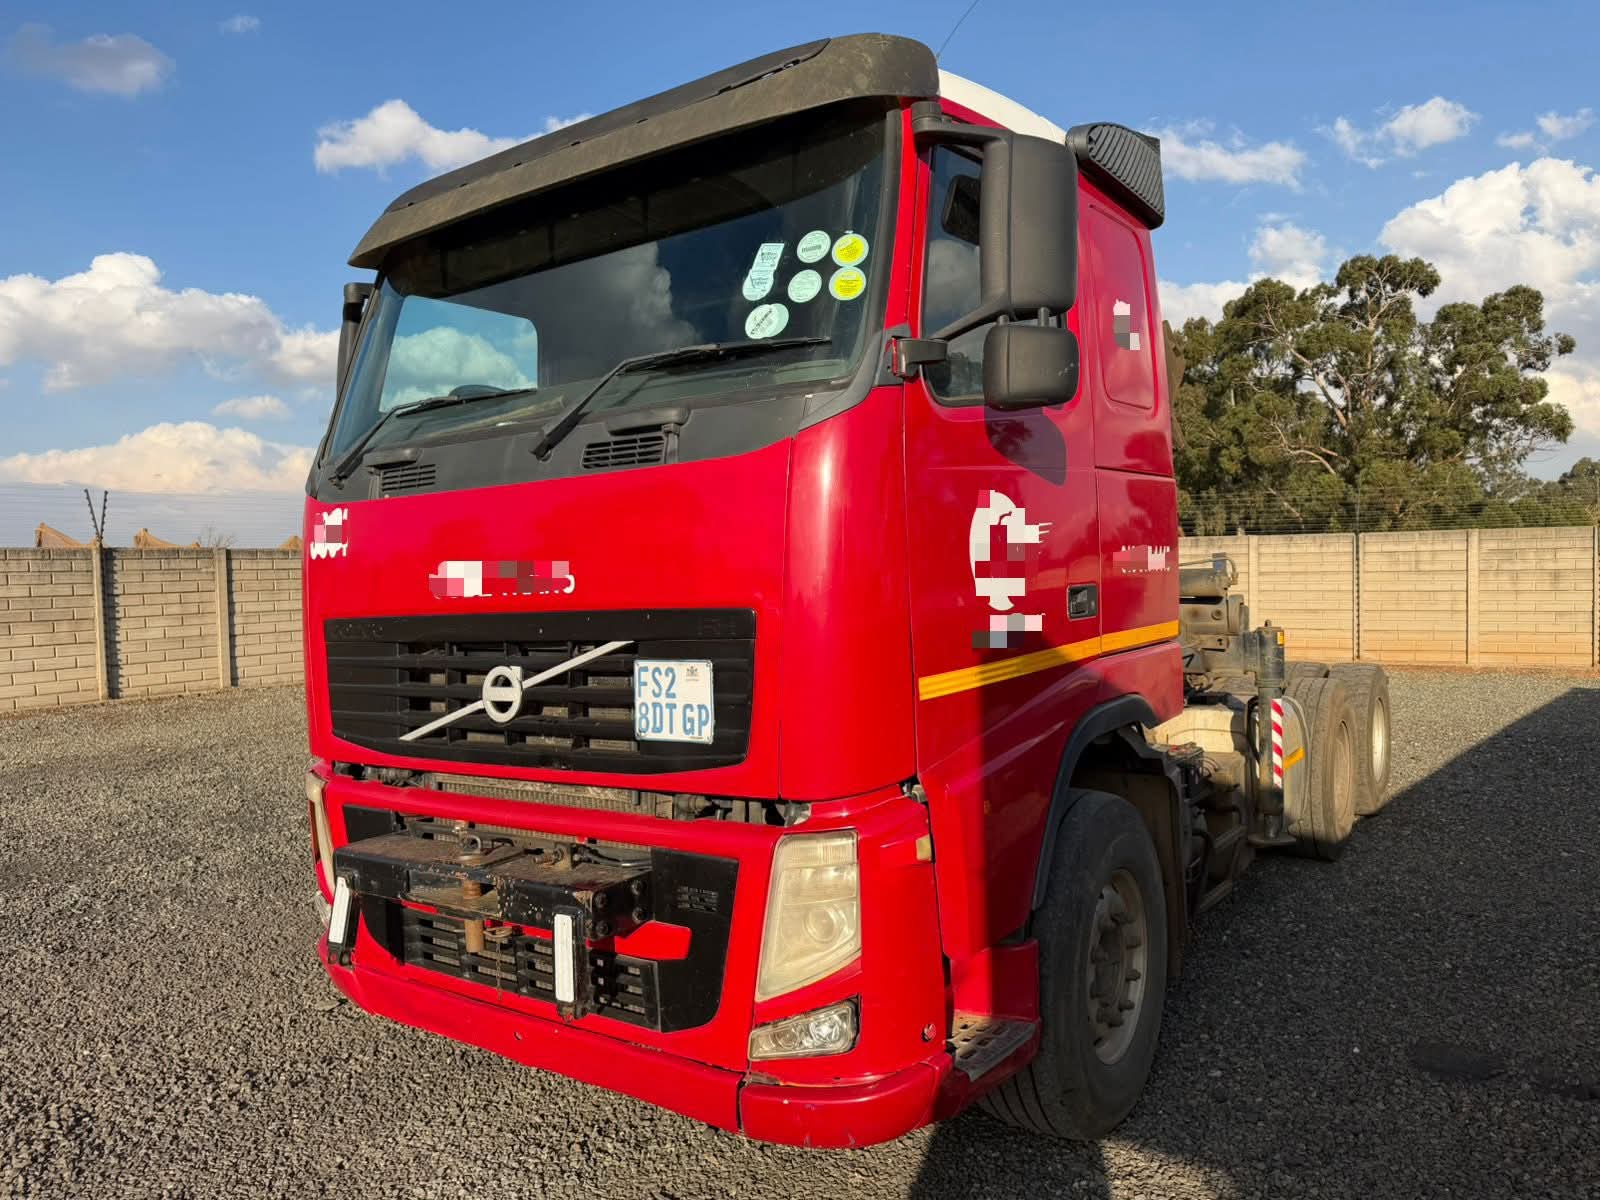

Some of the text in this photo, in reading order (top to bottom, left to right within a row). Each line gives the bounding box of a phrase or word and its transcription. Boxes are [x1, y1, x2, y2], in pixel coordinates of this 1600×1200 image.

[636, 665, 678, 699] FS2
[637, 702, 711, 737] 8DT GP
